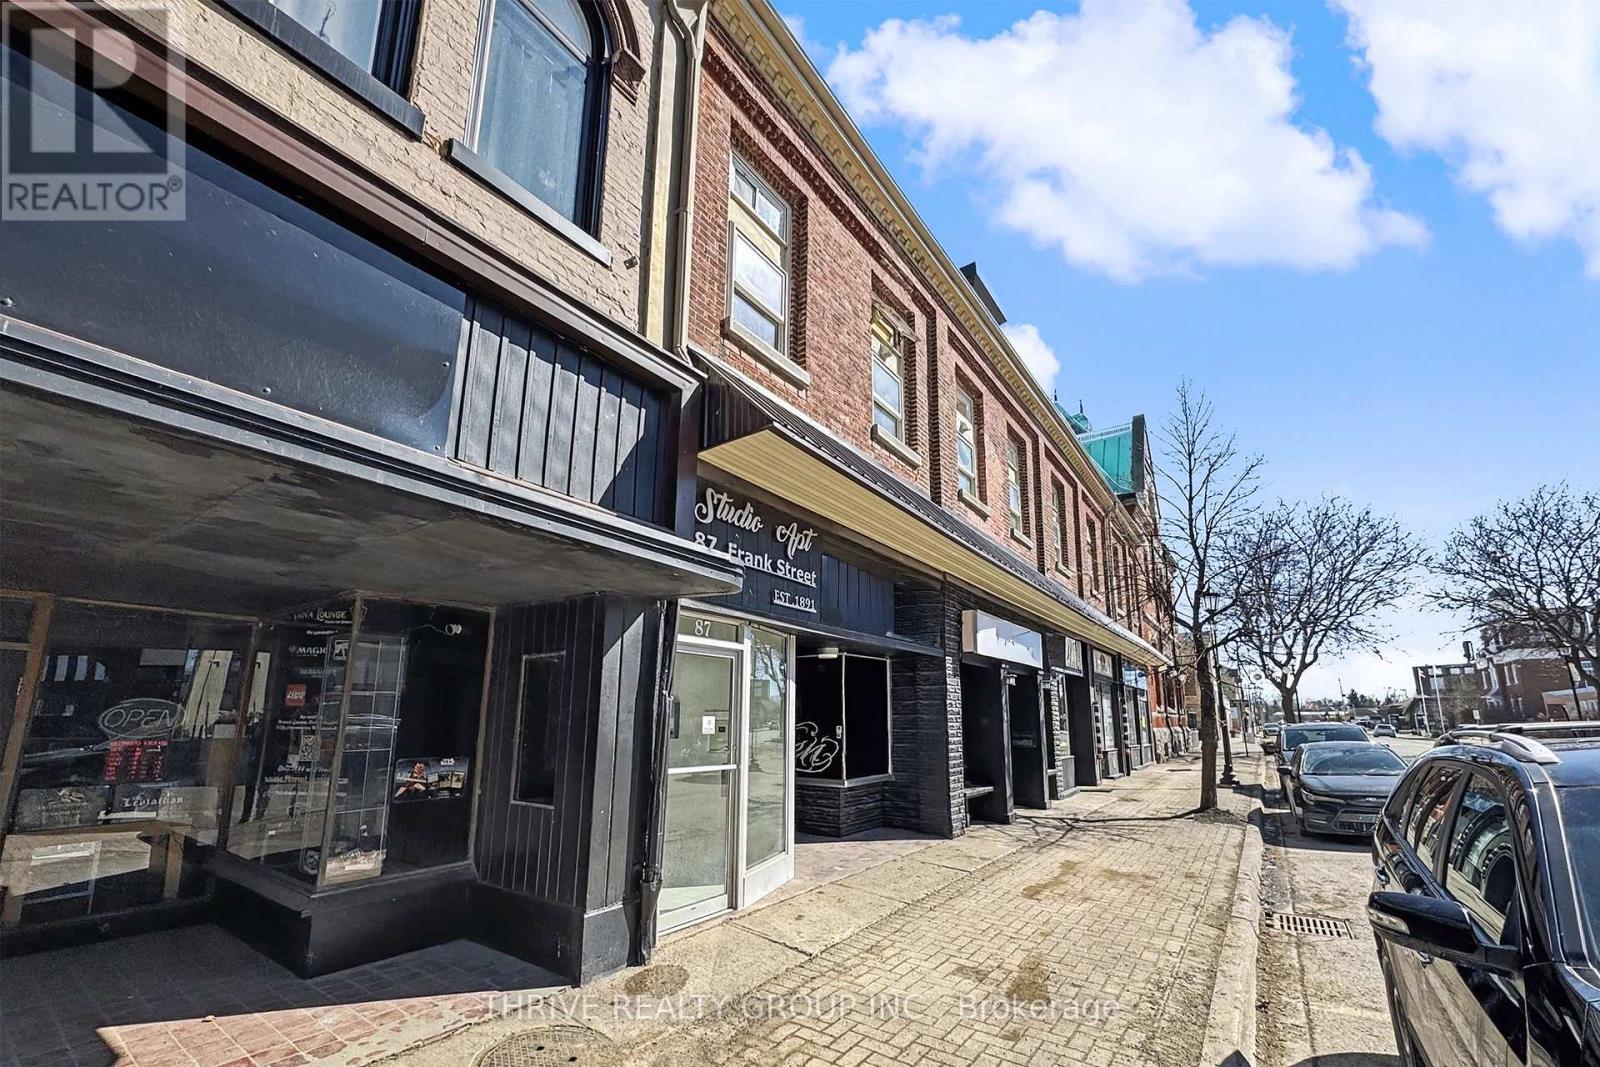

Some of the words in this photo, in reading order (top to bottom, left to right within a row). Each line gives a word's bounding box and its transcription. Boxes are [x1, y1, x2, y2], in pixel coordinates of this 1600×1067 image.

[694, 487, 764, 533] Studio
[775, 522, 818, 560] Apt
[694, 532, 717, 550] 87
[728, 542, 773, 573] Frank
[776, 559, 817, 588] Street
[694, 620, 711, 637] 87
[104, 708, 178, 729] OPEN
